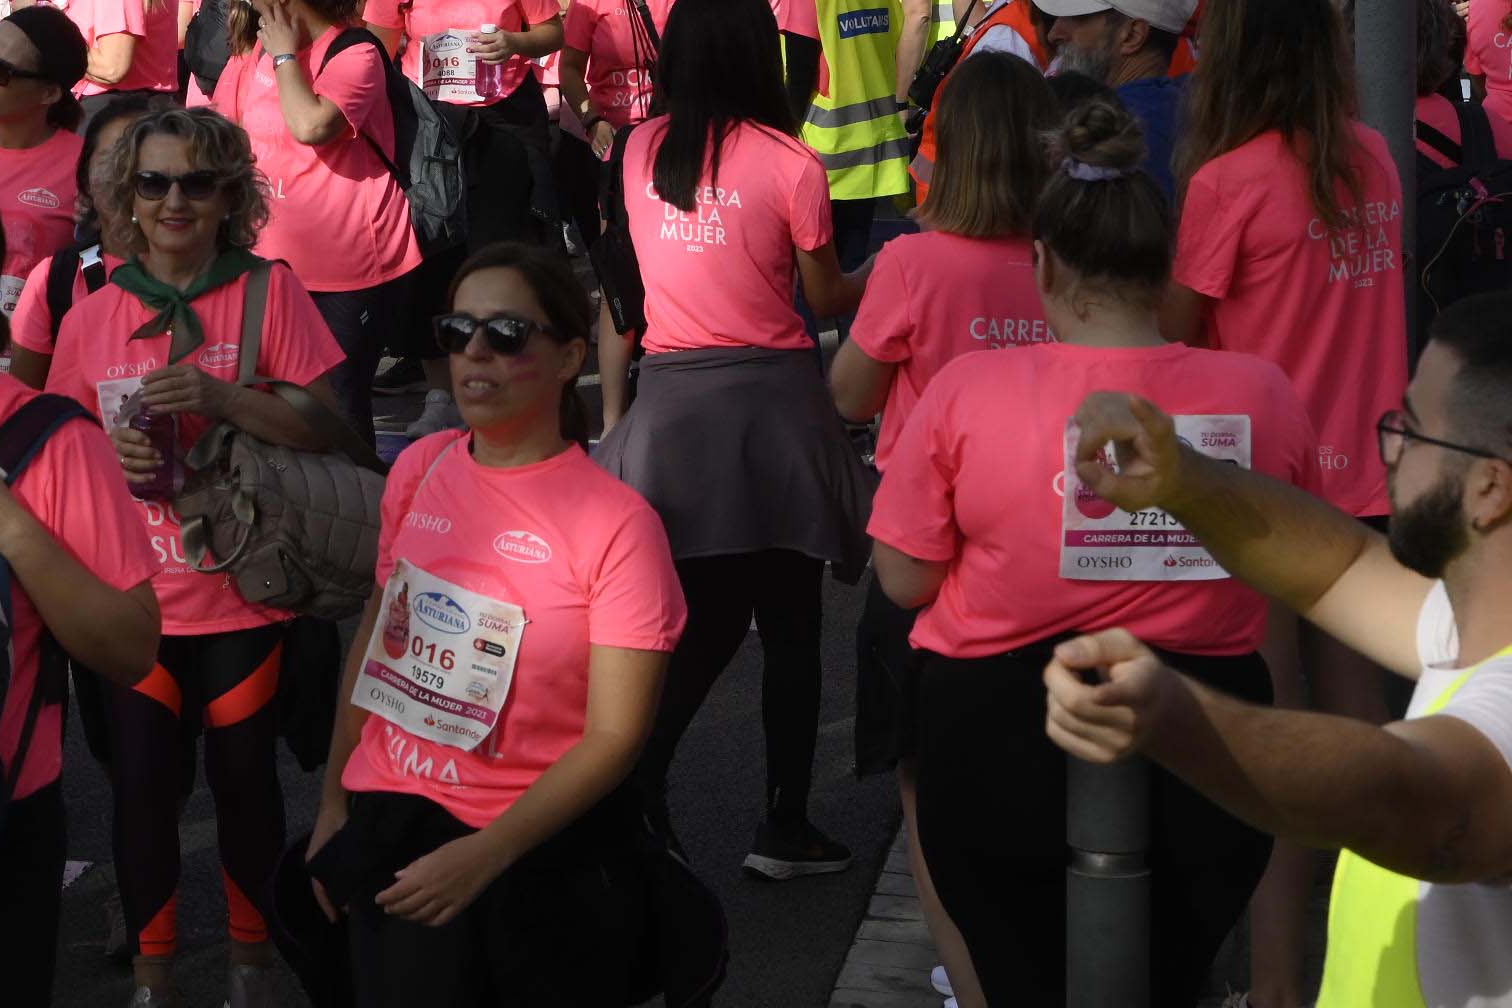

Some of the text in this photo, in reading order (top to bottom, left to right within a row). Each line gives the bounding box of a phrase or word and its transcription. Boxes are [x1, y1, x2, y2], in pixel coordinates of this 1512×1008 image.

[432, 56, 460, 68] 016
[645, 181, 743, 209] CERA
[698, 205, 722, 225] LA
[660, 222, 727, 246] MUJER
[1367, 225, 1389, 249] LA
[1328, 249, 1395, 284] MUJER
[106, 358, 157, 378] OYSHO
[1200, 438, 1236, 448] SUMA
[496, 537, 546, 561] ASTURIANA
[1083, 534, 1133, 543] CARRERA
[1133, 534, 1150, 543] DE
[1150, 534, 1165, 543] LA
[1077, 556, 1133, 569] OYSHO
[415, 598, 466, 631] ASTURIANA
[477, 617, 510, 634] SUMA
[411, 634, 455, 672] 016
[411, 663, 445, 690] 19579
[369, 686, 406, 715] OYSHO
[379, 667, 487, 720] CARRERA DE LA MUJER 2023
